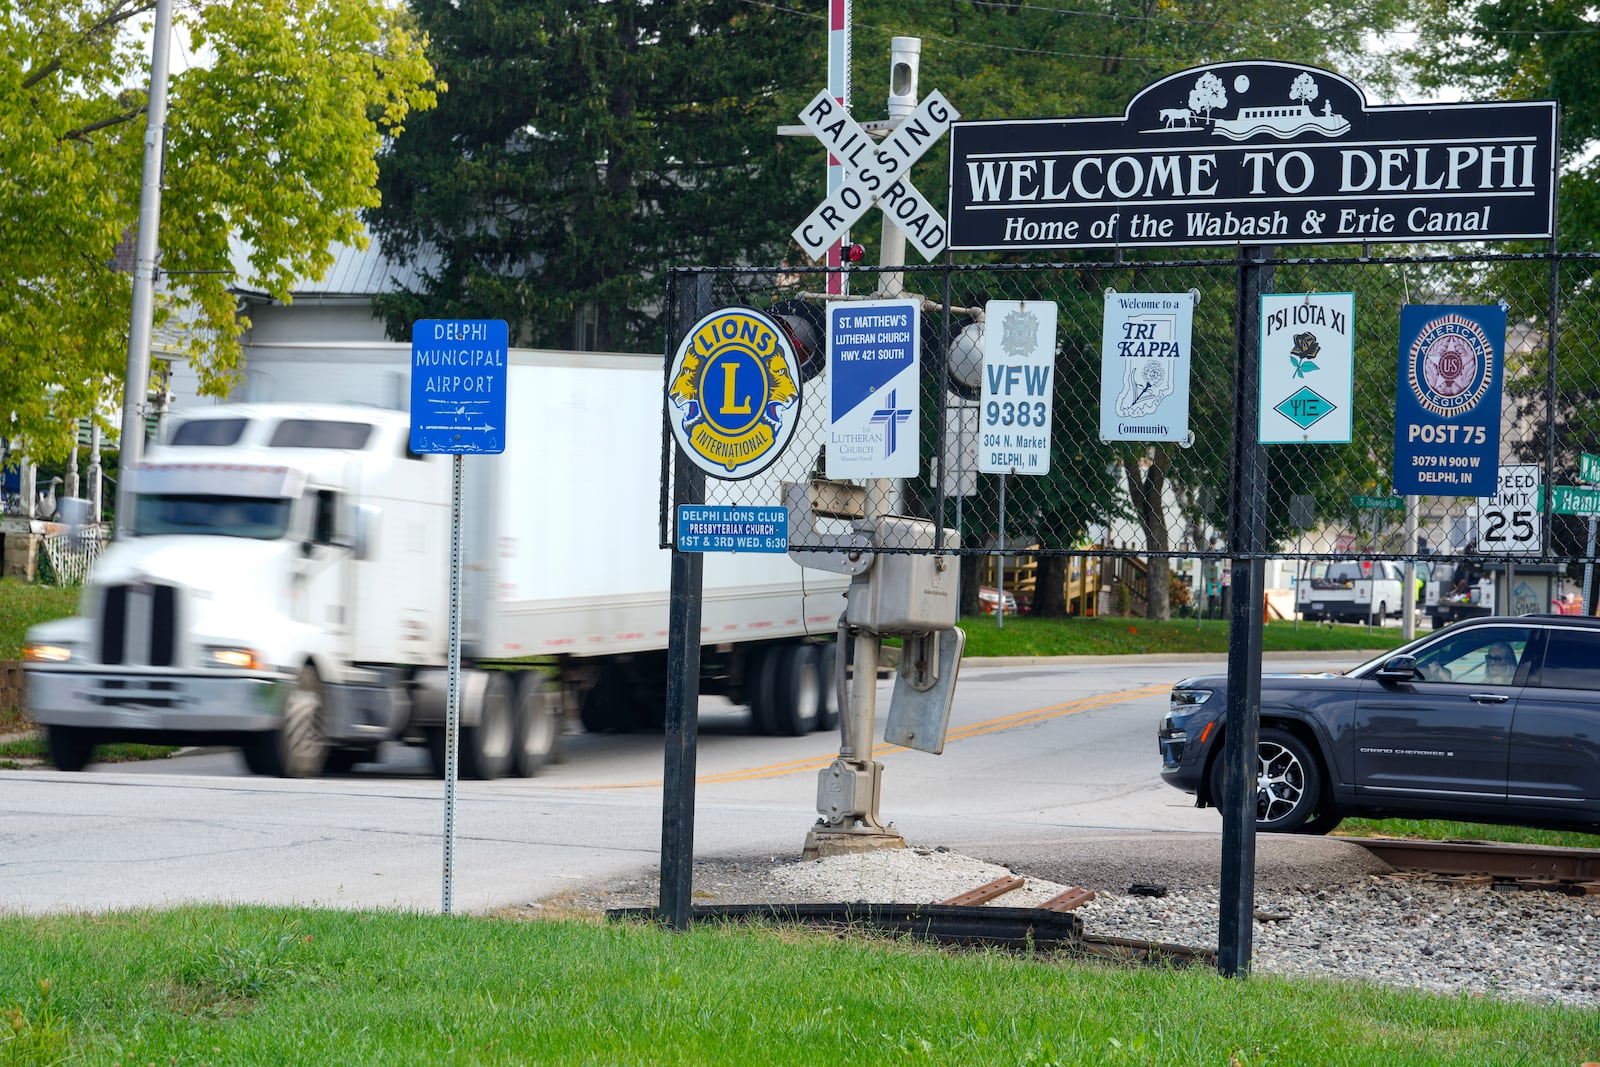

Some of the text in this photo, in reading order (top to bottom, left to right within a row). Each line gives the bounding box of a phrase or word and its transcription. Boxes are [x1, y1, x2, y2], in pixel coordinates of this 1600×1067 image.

[803, 100, 948, 248] CROSSING
[809, 98, 944, 249] RAIL ROAD
[966, 144, 1537, 202] WELCOME TO DELPHI
[1003, 205, 1491, 241] Home of the Wabash & Erie Canal
[1118, 298, 1179, 310] Welcome to a
[839, 315, 907, 329] ST. MATTHEW'S
[1267, 305, 1345, 336] PSI IOTA XI
[434, 323, 487, 341] DELPHI
[698, 319, 772, 352] LIONS
[835, 332, 910, 345] LUTHERAN CHURCH
[1122, 322, 1157, 340] TRI
[1420, 325, 1483, 356] AMERICAN
[416, 349, 503, 367] MUNICIPAL
[841, 349, 904, 361] HWY. 421 SOUTH
[1117, 341, 1180, 358] KAPPA
[1444, 358, 1458, 373] US
[425, 376, 493, 393] AIRPORT
[987, 364, 1050, 396] VFW
[720, 363, 751, 415] L
[1425, 390, 1472, 407] LEGION
[986, 401, 1046, 427] 9383
[831, 431, 882, 443] LUTHERAN
[1118, 423, 1170, 437] Community
[1408, 424, 1486, 444] POST 75
[696, 429, 768, 458] INTERNATIONAL
[840, 444, 873, 454] CHURCH
[983, 434, 1046, 449] 304 N. Market
[991, 452, 1037, 469] DELPHI, IN
[1412, 456, 1480, 467] 3079 N 900 W
[1418, 471, 1472, 484] DELPHI, IN
[682, 511, 785, 522] DELPHI LIONS CLUB
[689, 523, 774, 535] PRESBYTERIAN CHURCH
[1485, 511, 1534, 542] 25
[680, 536, 786, 548] 1ST & 3RD WED. 6:30
